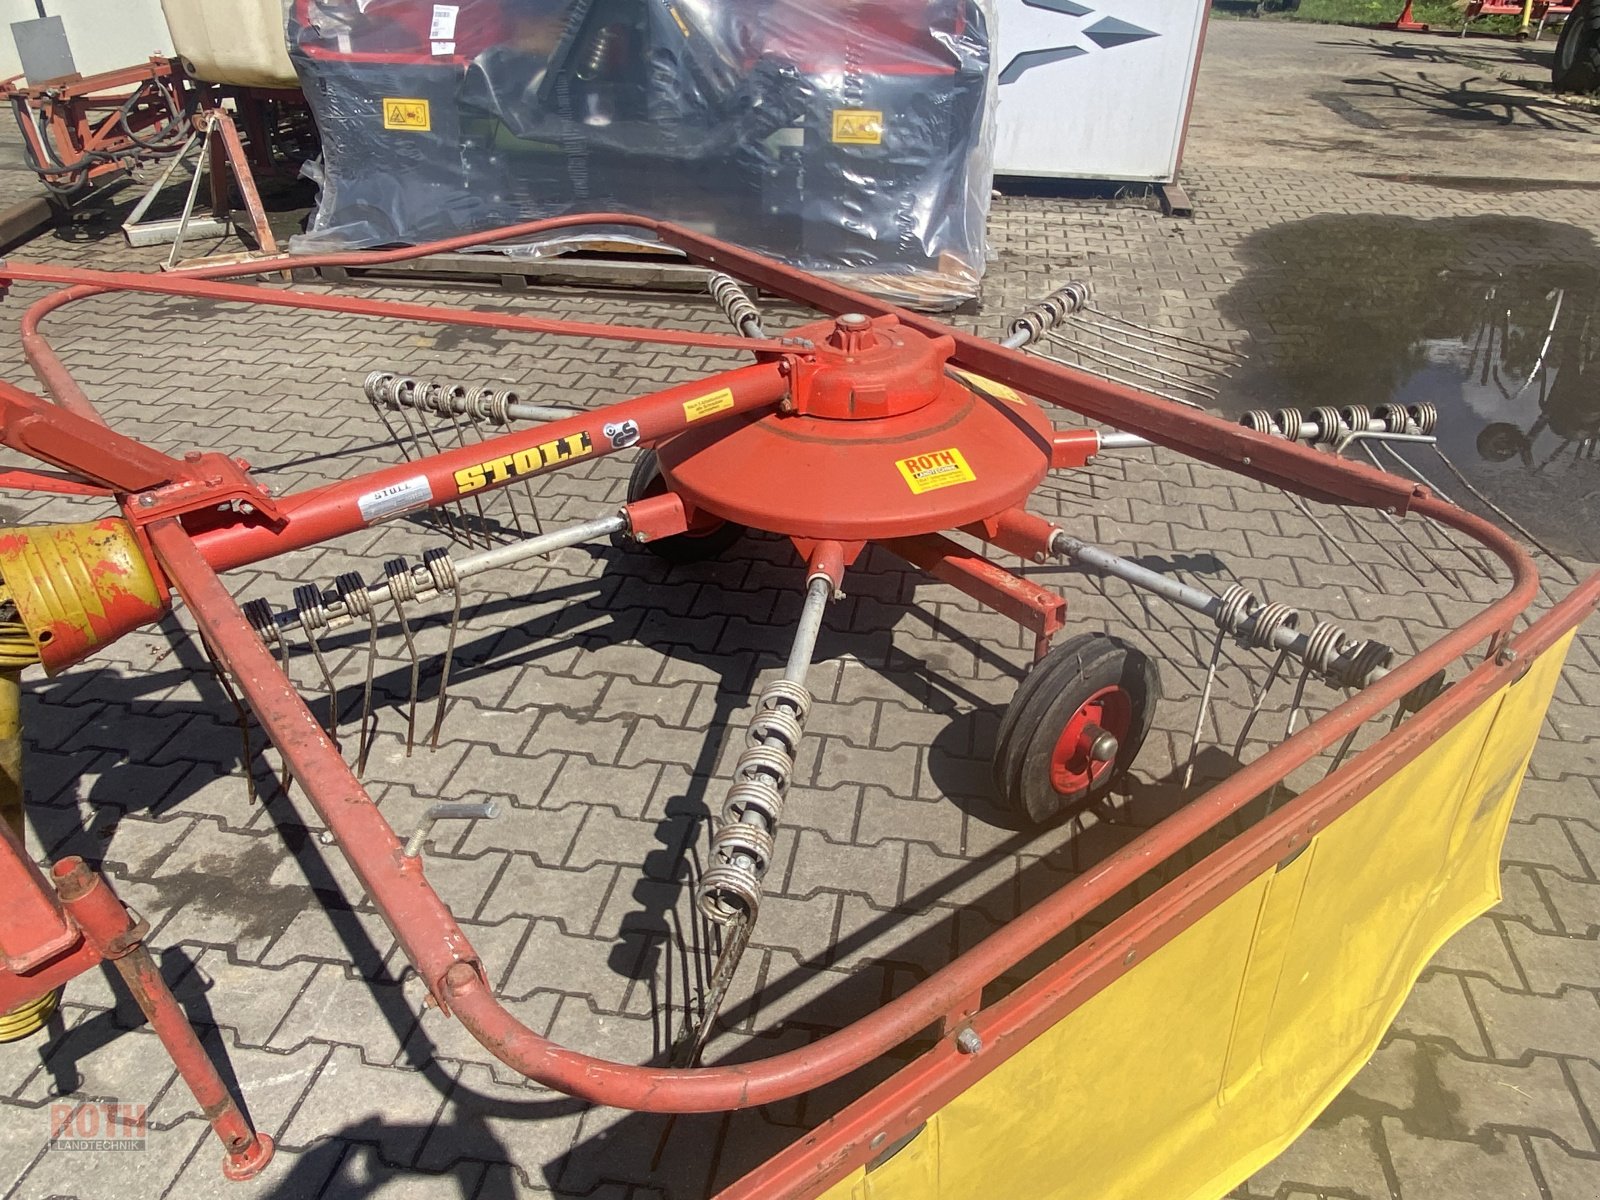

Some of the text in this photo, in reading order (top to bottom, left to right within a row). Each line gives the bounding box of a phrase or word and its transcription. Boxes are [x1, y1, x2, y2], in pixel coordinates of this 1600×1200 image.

[612, 423, 638, 447] GS
[454, 432, 592, 494] STOLL
[904, 451, 956, 473] ROTH
